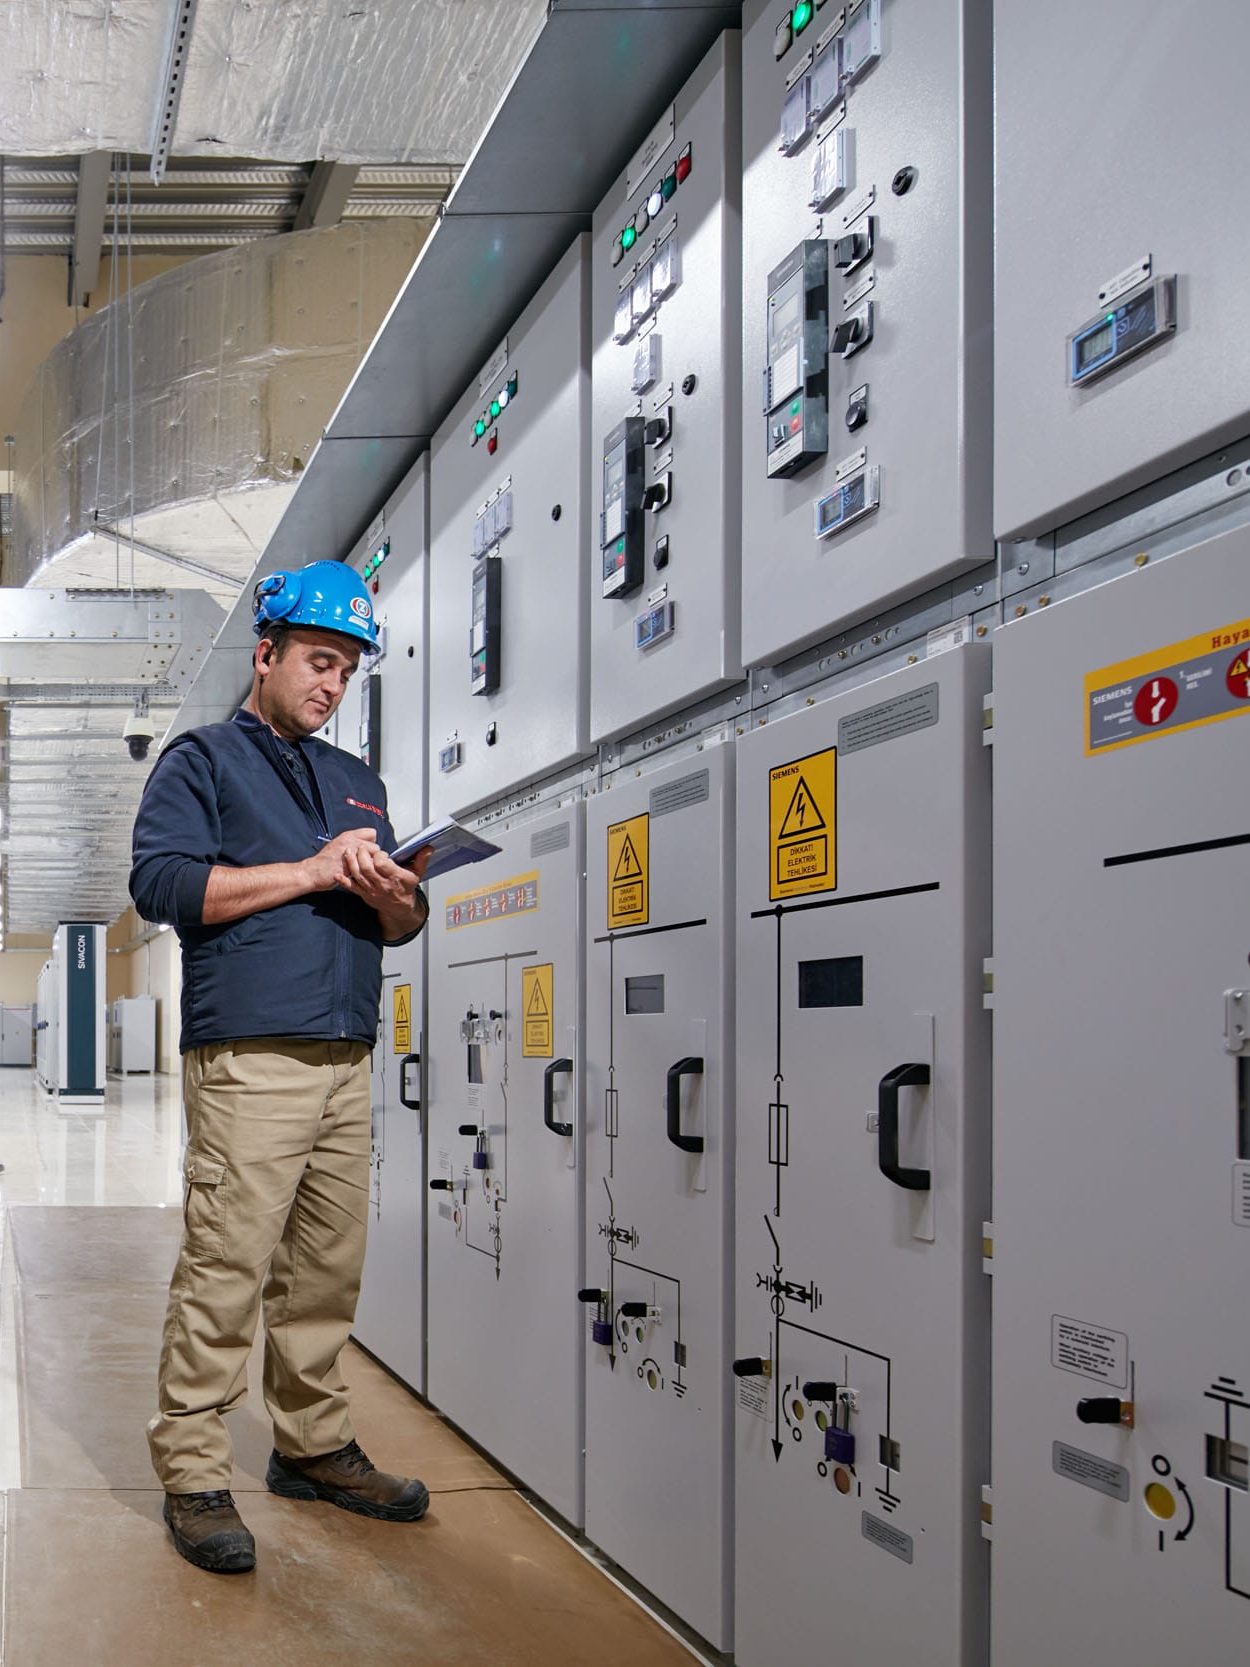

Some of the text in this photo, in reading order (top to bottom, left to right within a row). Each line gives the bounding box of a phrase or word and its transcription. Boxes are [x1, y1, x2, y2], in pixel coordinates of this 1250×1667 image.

[1093, 686, 1133, 705] SIEMENS
[771, 766, 800, 781] SIEMENS
[78, 934, 86, 969] SIVACON
